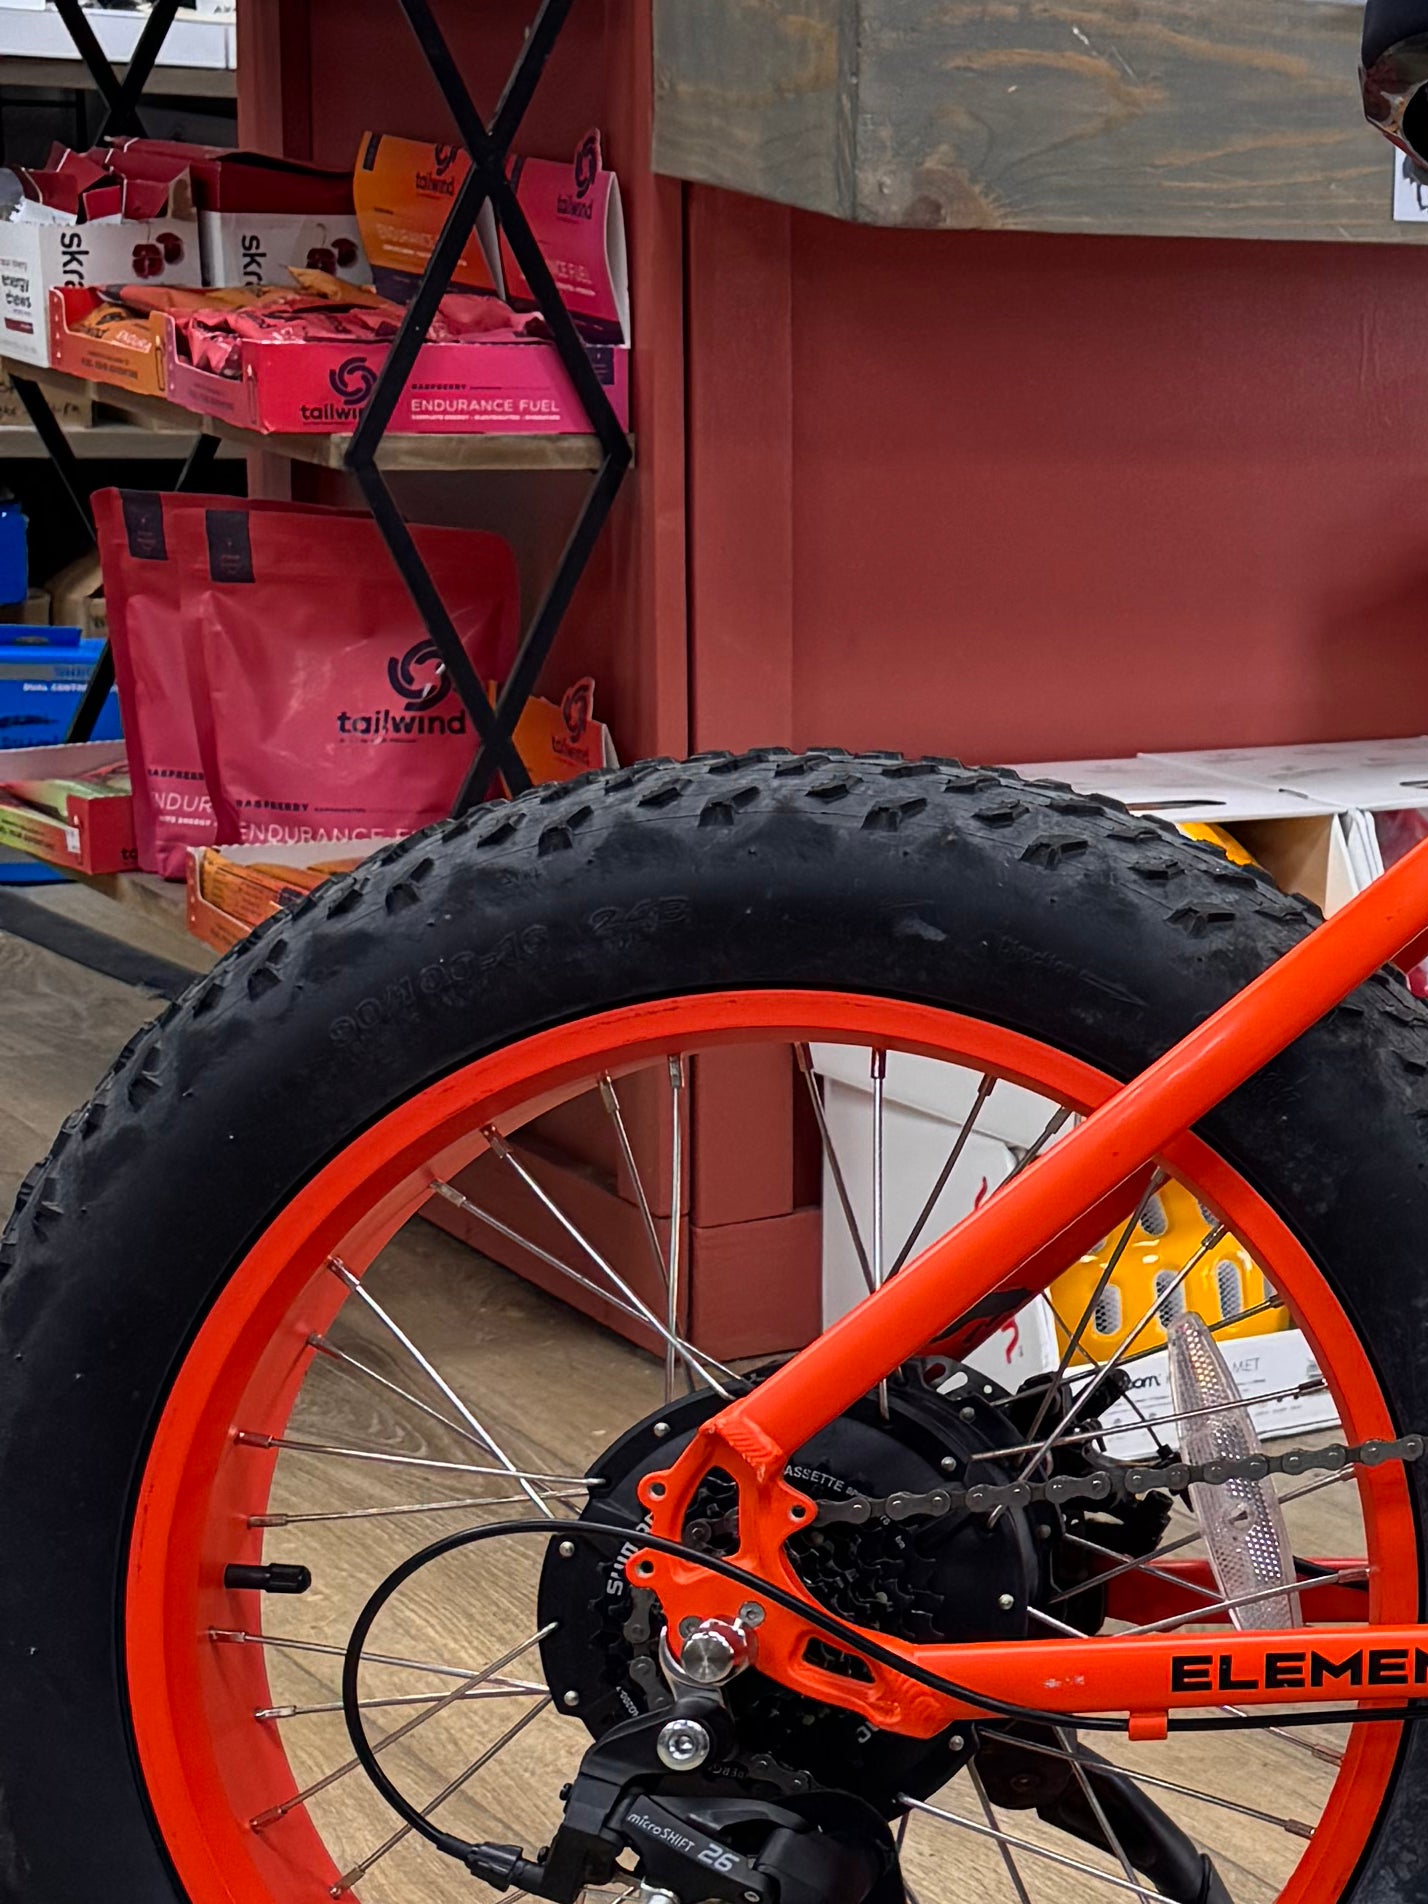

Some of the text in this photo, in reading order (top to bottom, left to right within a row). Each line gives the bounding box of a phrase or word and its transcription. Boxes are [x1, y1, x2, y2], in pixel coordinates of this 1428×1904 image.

[415, 171, 456, 198] tailwind
[556, 195, 594, 220] tailwind
[411, 399, 560, 413] ENDURANCE FUEL
[336, 709, 468, 737] tailwind
[236, 799, 309, 812] RASPBERRY
[783, 1464, 846, 1493] ASSETTE
[626, 1811, 741, 1873] microSHIFT 26
